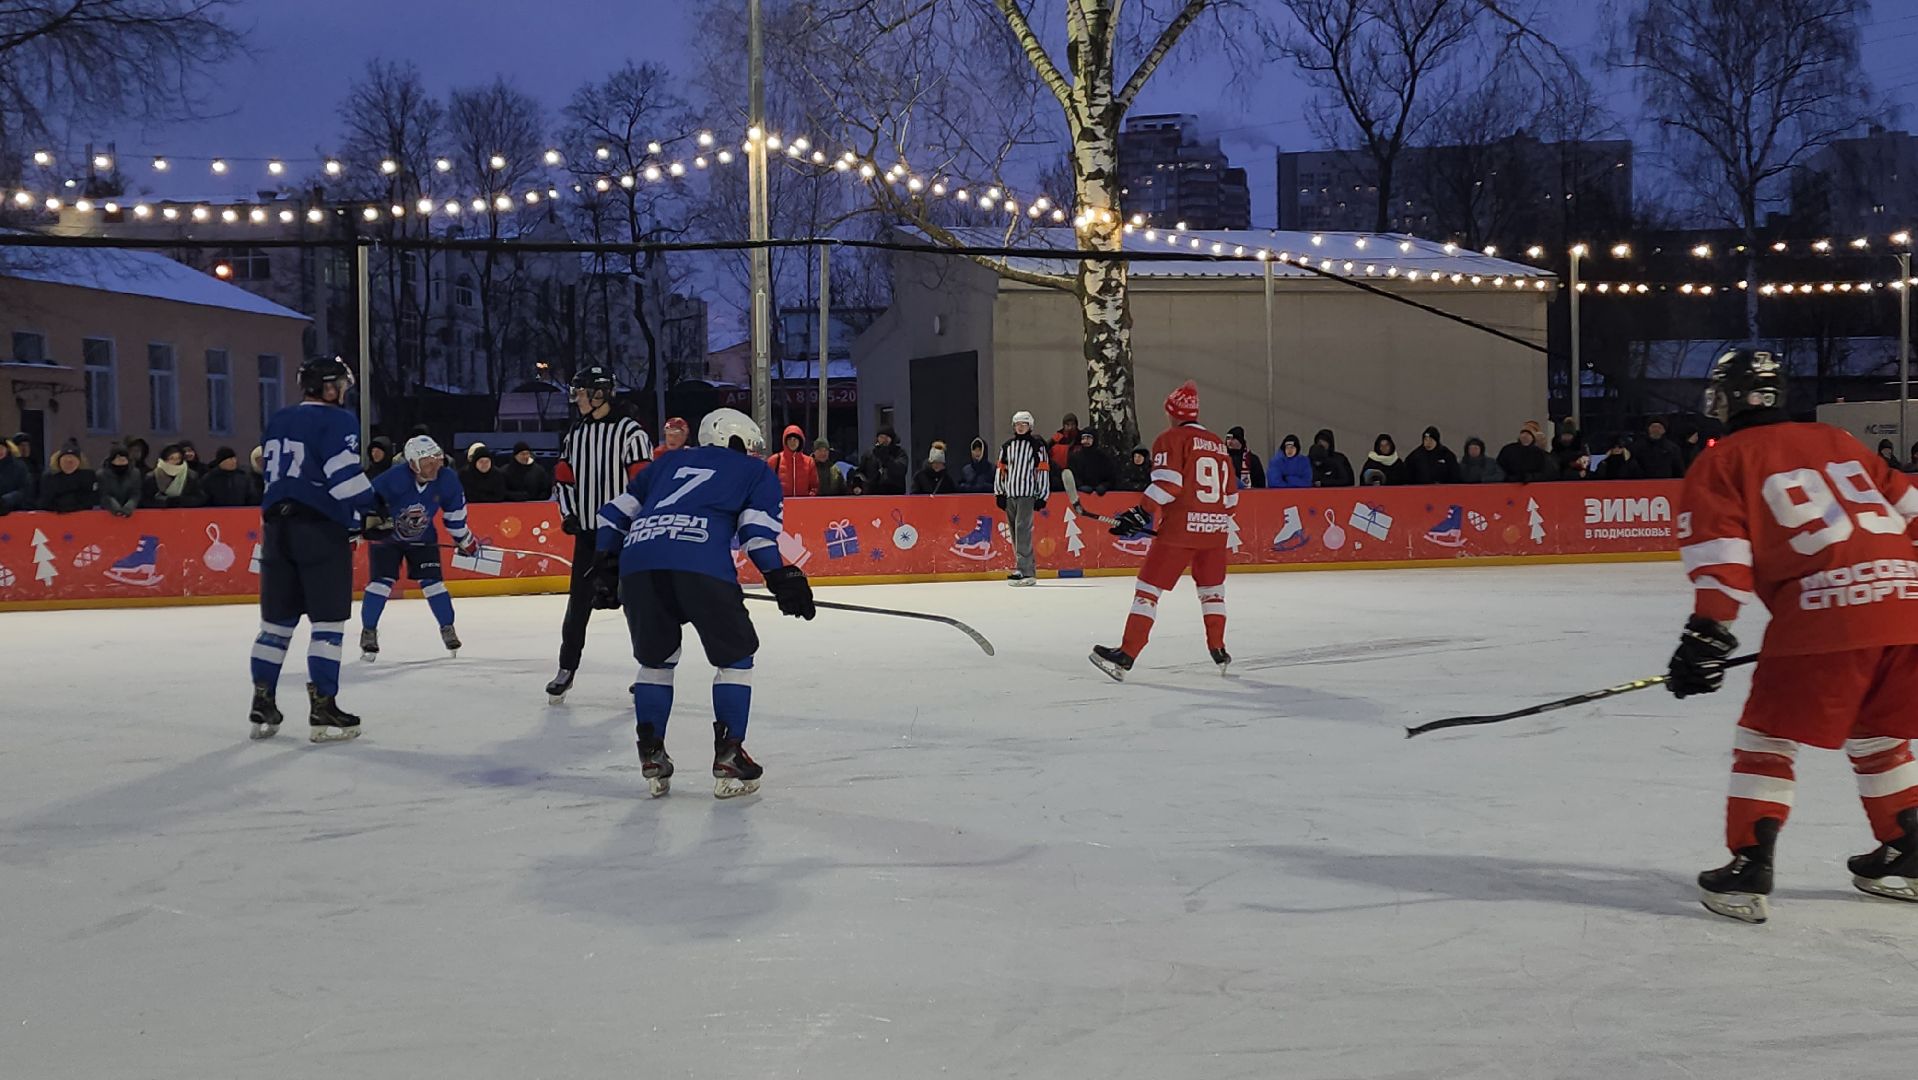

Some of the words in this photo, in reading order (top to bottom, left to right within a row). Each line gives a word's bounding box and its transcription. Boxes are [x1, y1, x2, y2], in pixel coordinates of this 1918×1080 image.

[809, 391, 857, 403] 95-20
[1154, 452, 1168, 466] 91
[654, 466, 717, 510] 7
[1196, 457, 1229, 503] 91
[1584, 496, 1671, 523] ЗИМА
[1762, 460, 1907, 555] 99
[631, 514, 708, 532] ОСОБЛ
[1585, 529, 1593, 539] В
[1594, 527, 1671, 539] ПОДМОСКОВЬЕ
[1800, 579, 1911, 610] СПОРТ
